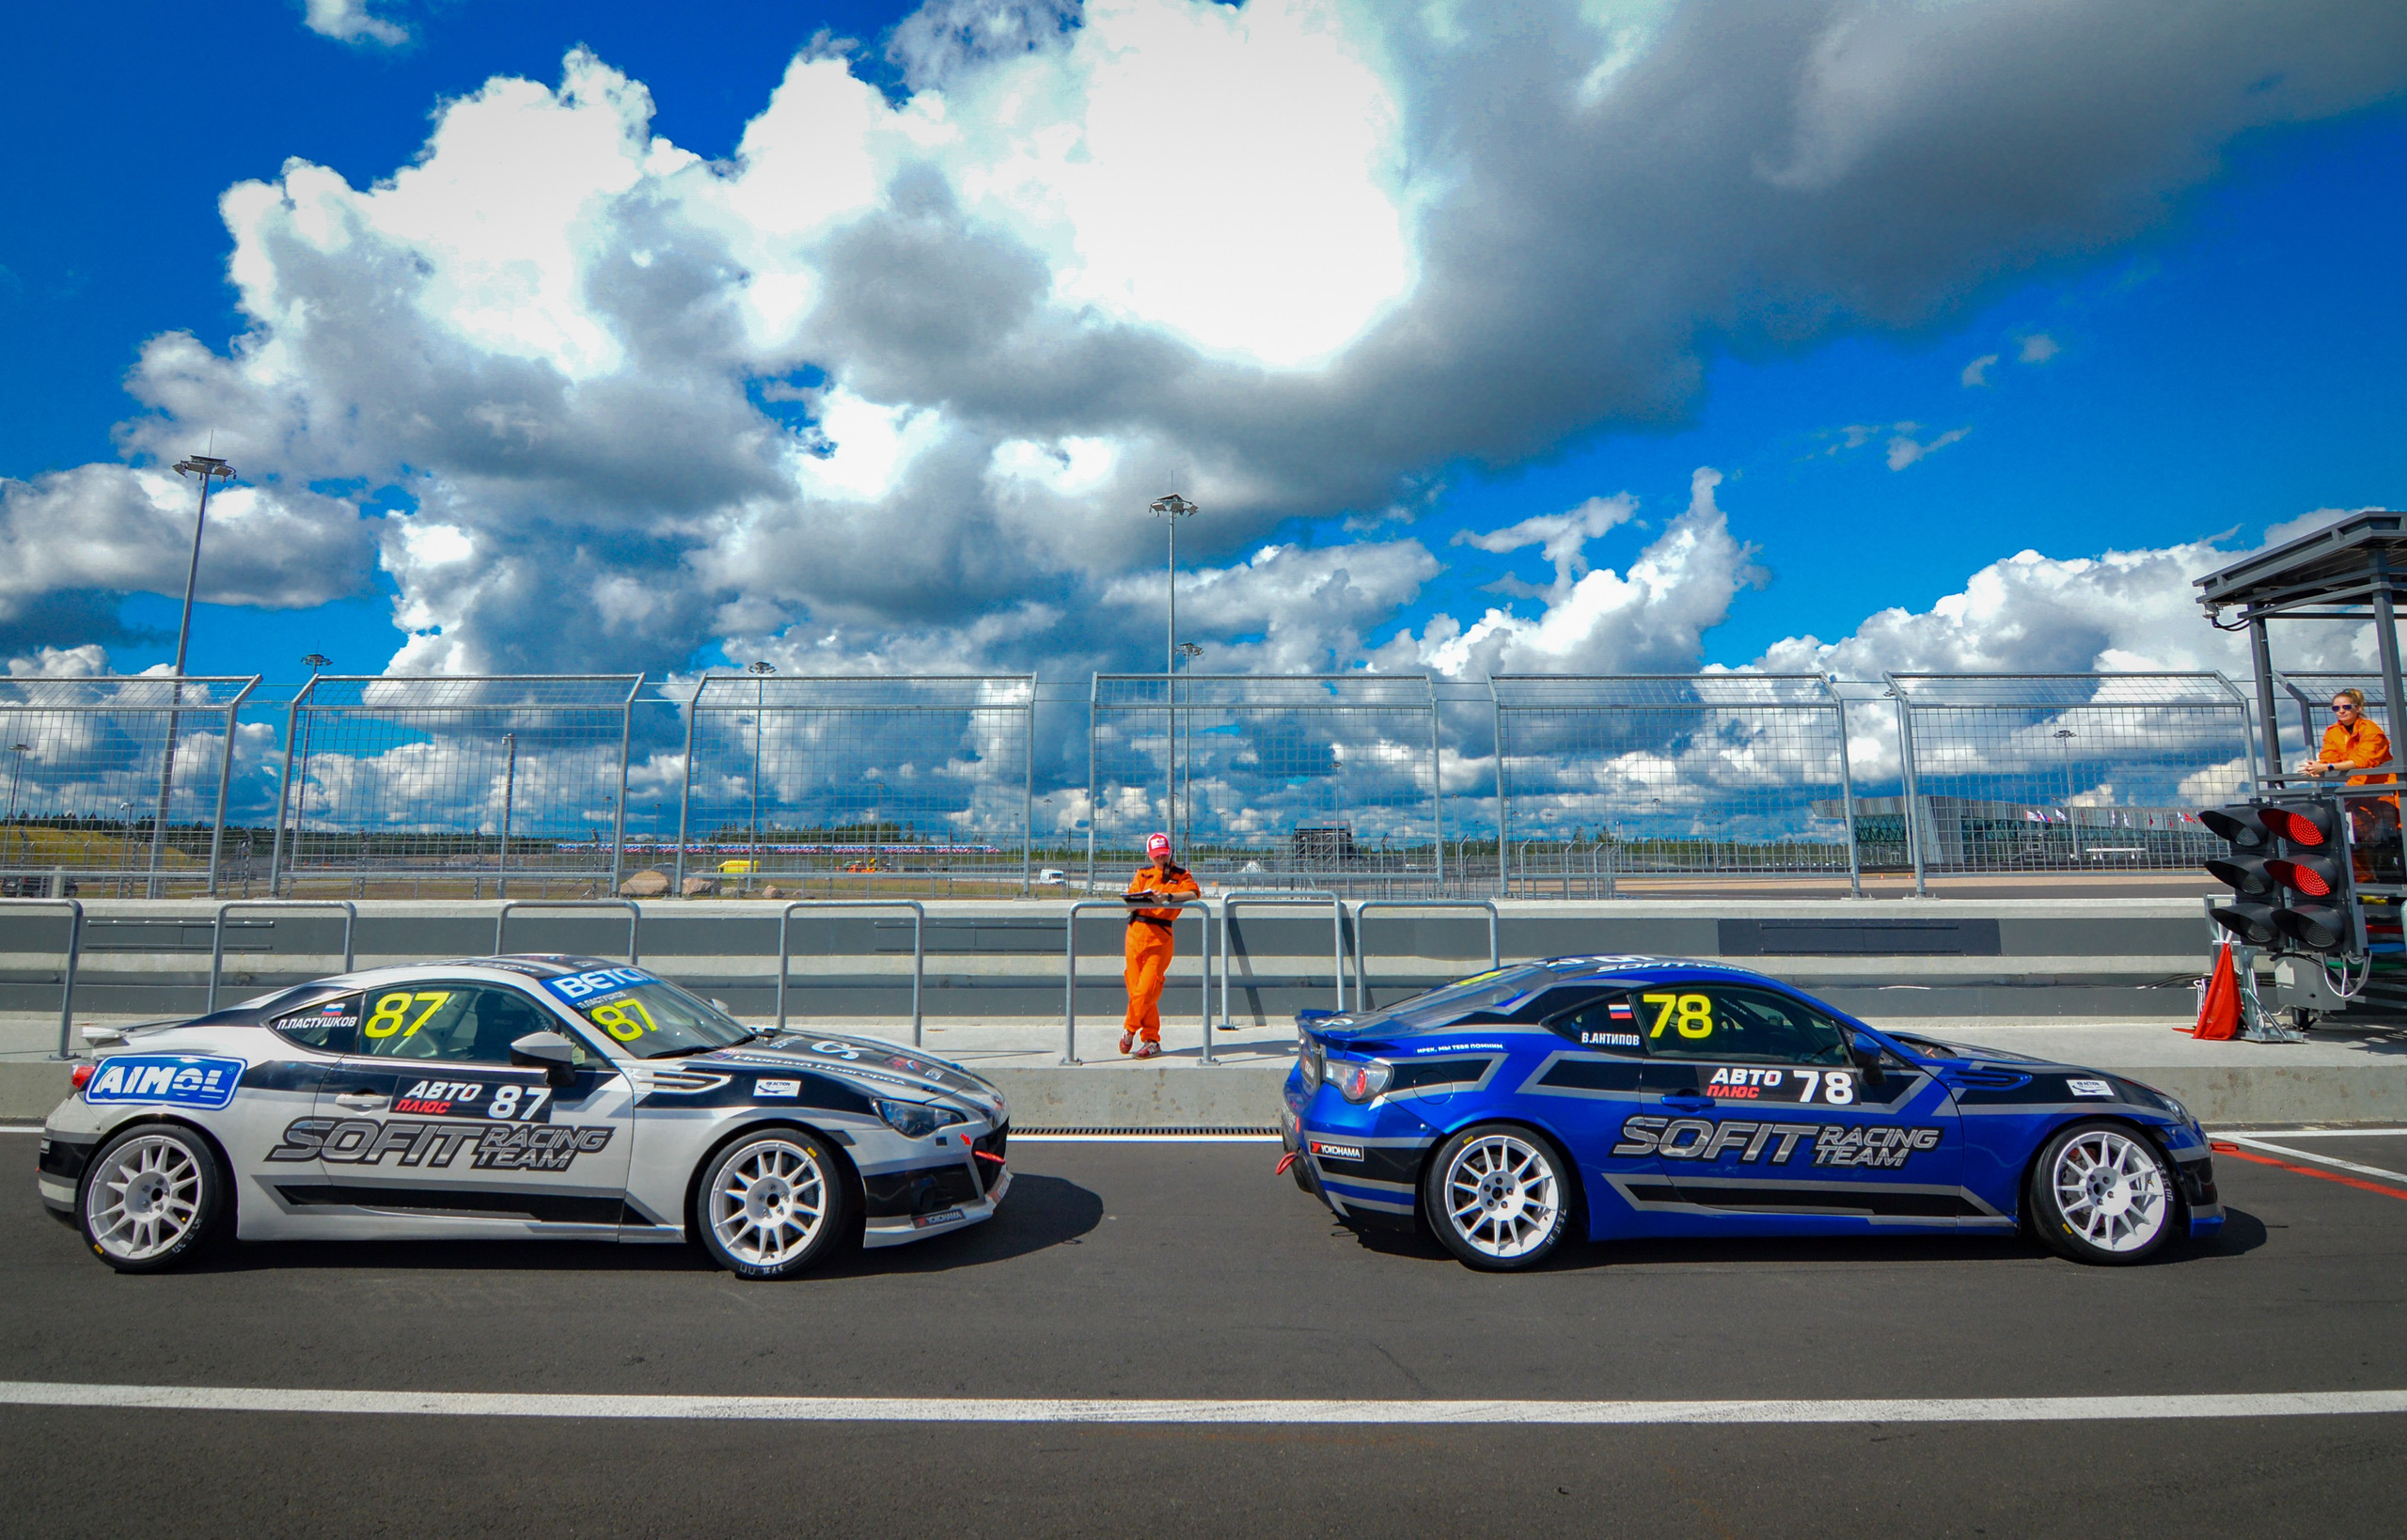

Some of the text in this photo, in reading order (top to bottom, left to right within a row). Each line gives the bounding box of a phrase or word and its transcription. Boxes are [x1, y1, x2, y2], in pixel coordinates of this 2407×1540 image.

[276, 1016, 358, 1030] П.ПАСТУШКОВ
[365, 992, 450, 1038] 87
[590, 998, 658, 1042] 87
[1643, 994, 1713, 1039] 78
[1581, 1032, 1641, 1046] В.АНТИПОВ
[92, 1065, 226, 1099] AIMOL
[1710, 1068, 1783, 1087] АВТО
[1793, 1070, 1854, 1105] 78
[404, 1080, 483, 1102] АВТО
[488, 1085, 552, 1121] 87
[1707, 1085, 1760, 1099] ПЛЮС
[395, 1099, 451, 1114] ПЛЮС
[265, 1117, 612, 1166] SOFIT RACING
[1320, 1143, 1361, 1157] YOKOHAMA
[1612, 1116, 1940, 1163] SOFIT RACING
[477, 1145, 574, 1169] TEAM
[1816, 1144, 1910, 1168] TEAM
